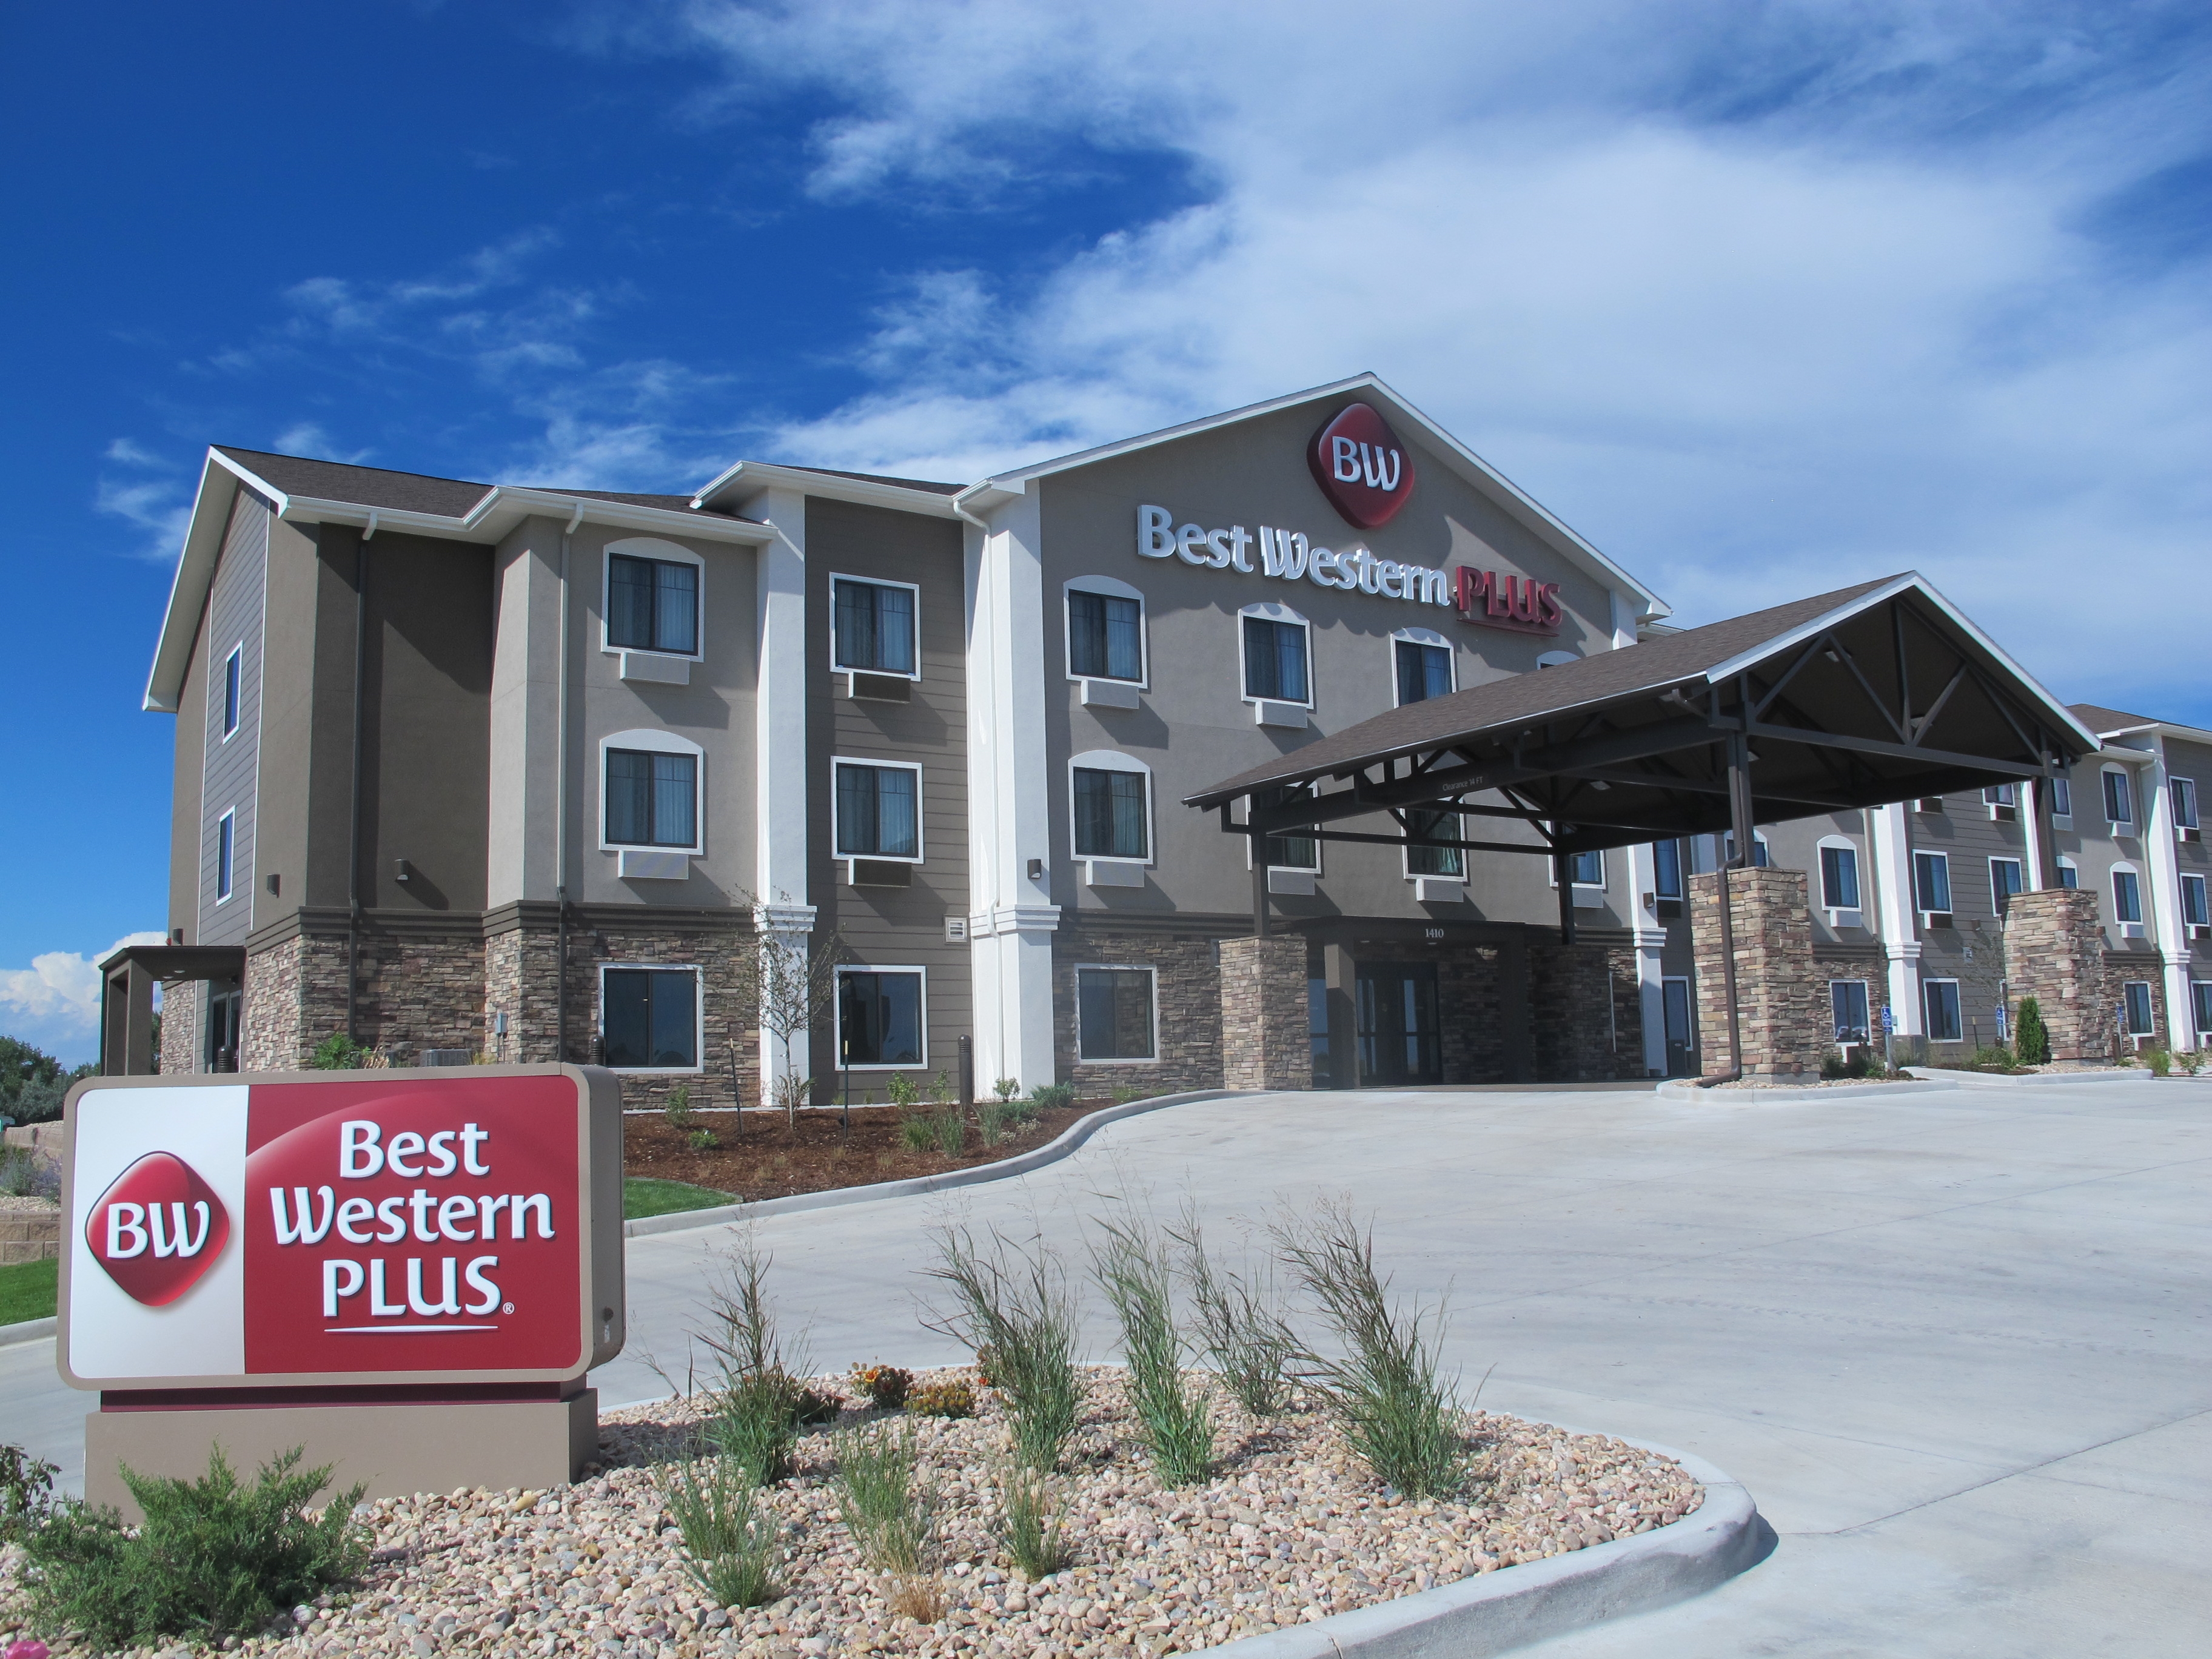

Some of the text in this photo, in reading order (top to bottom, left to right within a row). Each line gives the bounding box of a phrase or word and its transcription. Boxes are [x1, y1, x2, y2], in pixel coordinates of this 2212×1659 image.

[1333, 436, 1402, 492] BW
[1136, 504, 1564, 628] Best Western PLUS
[1442, 780, 1468, 791] Clearance
[1476, 776, 1484, 785] FT
[1425, 928, 1444, 938] 1410
[340, 1119, 490, 1179] Best
[106, 1201, 210, 1259] BW
[269, 1185, 556, 1245] Western
